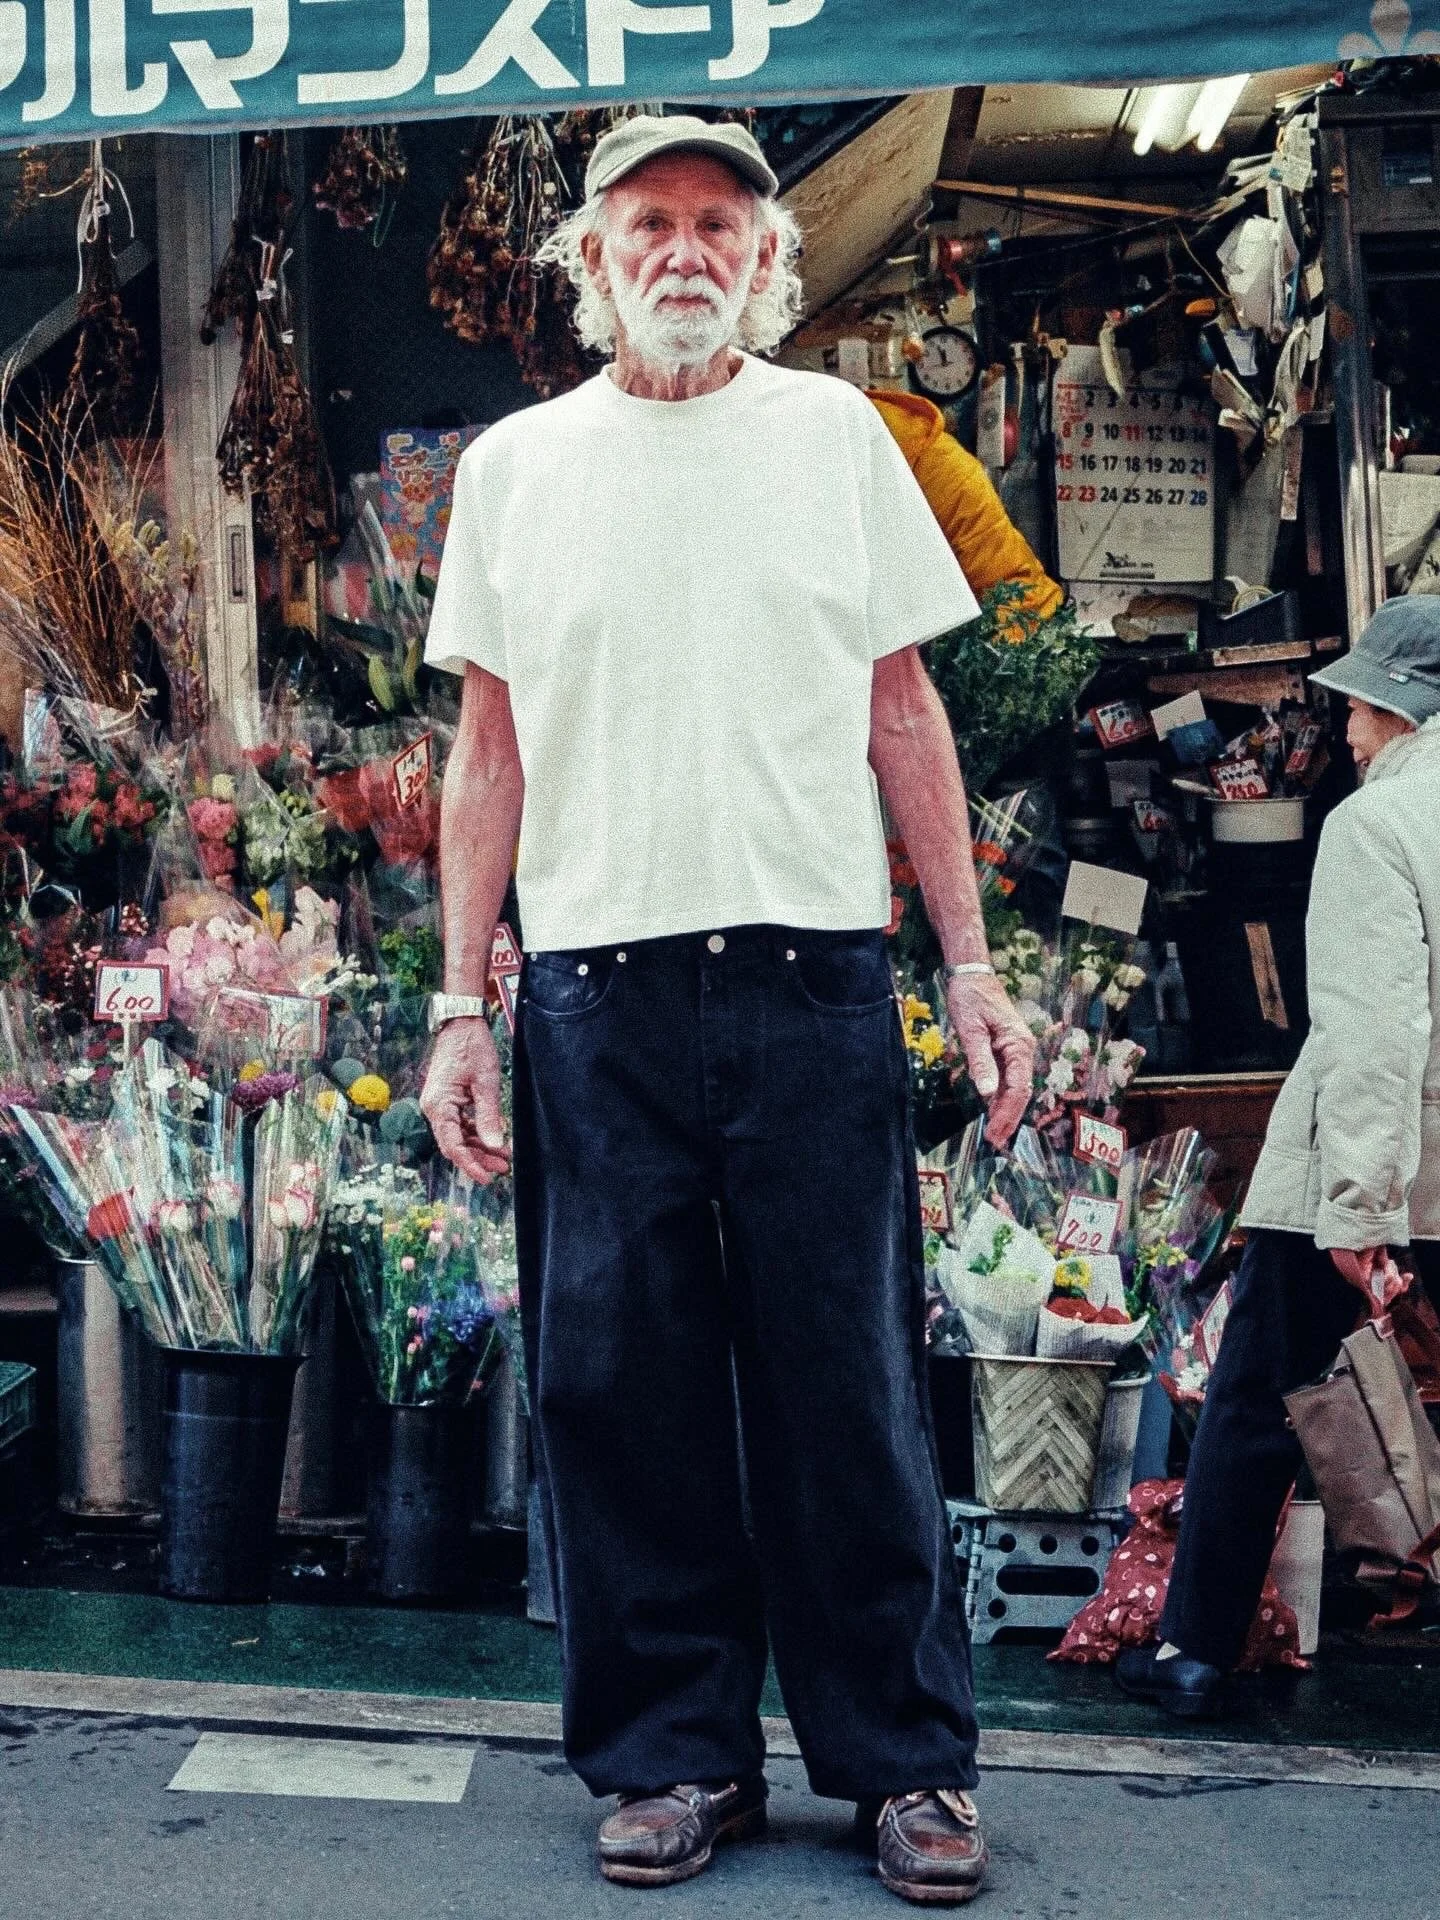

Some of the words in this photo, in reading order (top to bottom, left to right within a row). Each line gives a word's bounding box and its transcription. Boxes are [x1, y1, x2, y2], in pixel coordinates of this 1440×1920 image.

[1085, 389, 1095, 408] 2
[1062, 420, 1072, 438] 8
[1084, 422, 1095, 439] 9
[1103, 423, 1120, 440] 10
[1124, 423, 1141, 441] 11
[1147, 424, 1163, 442] 12
[1057, 453, 1073, 471] 15
[1080, 454, 1097, 471] 16
[1102, 455, 1119, 472] 17
[1124, 456, 1141, 473] 18
[1146, 456, 1163, 473] 19
[1168, 457, 1186, 474] 20
[1190, 458, 1207, 475] 21
[1057, 484, 1073, 502] 22
[1078, 485, 1096, 503] 23
[1100, 486, 1118, 503] 24
[1122, 487, 1141, 504] 25
[1144, 488, 1163, 505] 26
[1167, 488, 1185, 506] 27
[1189, 489, 1208, 507] 28
[405, 763, 428, 800] 300
[106, 986, 154, 1011] 600
[1085, 1133, 1120, 1163] 500
[1062, 1219, 1103, 1247] 700
